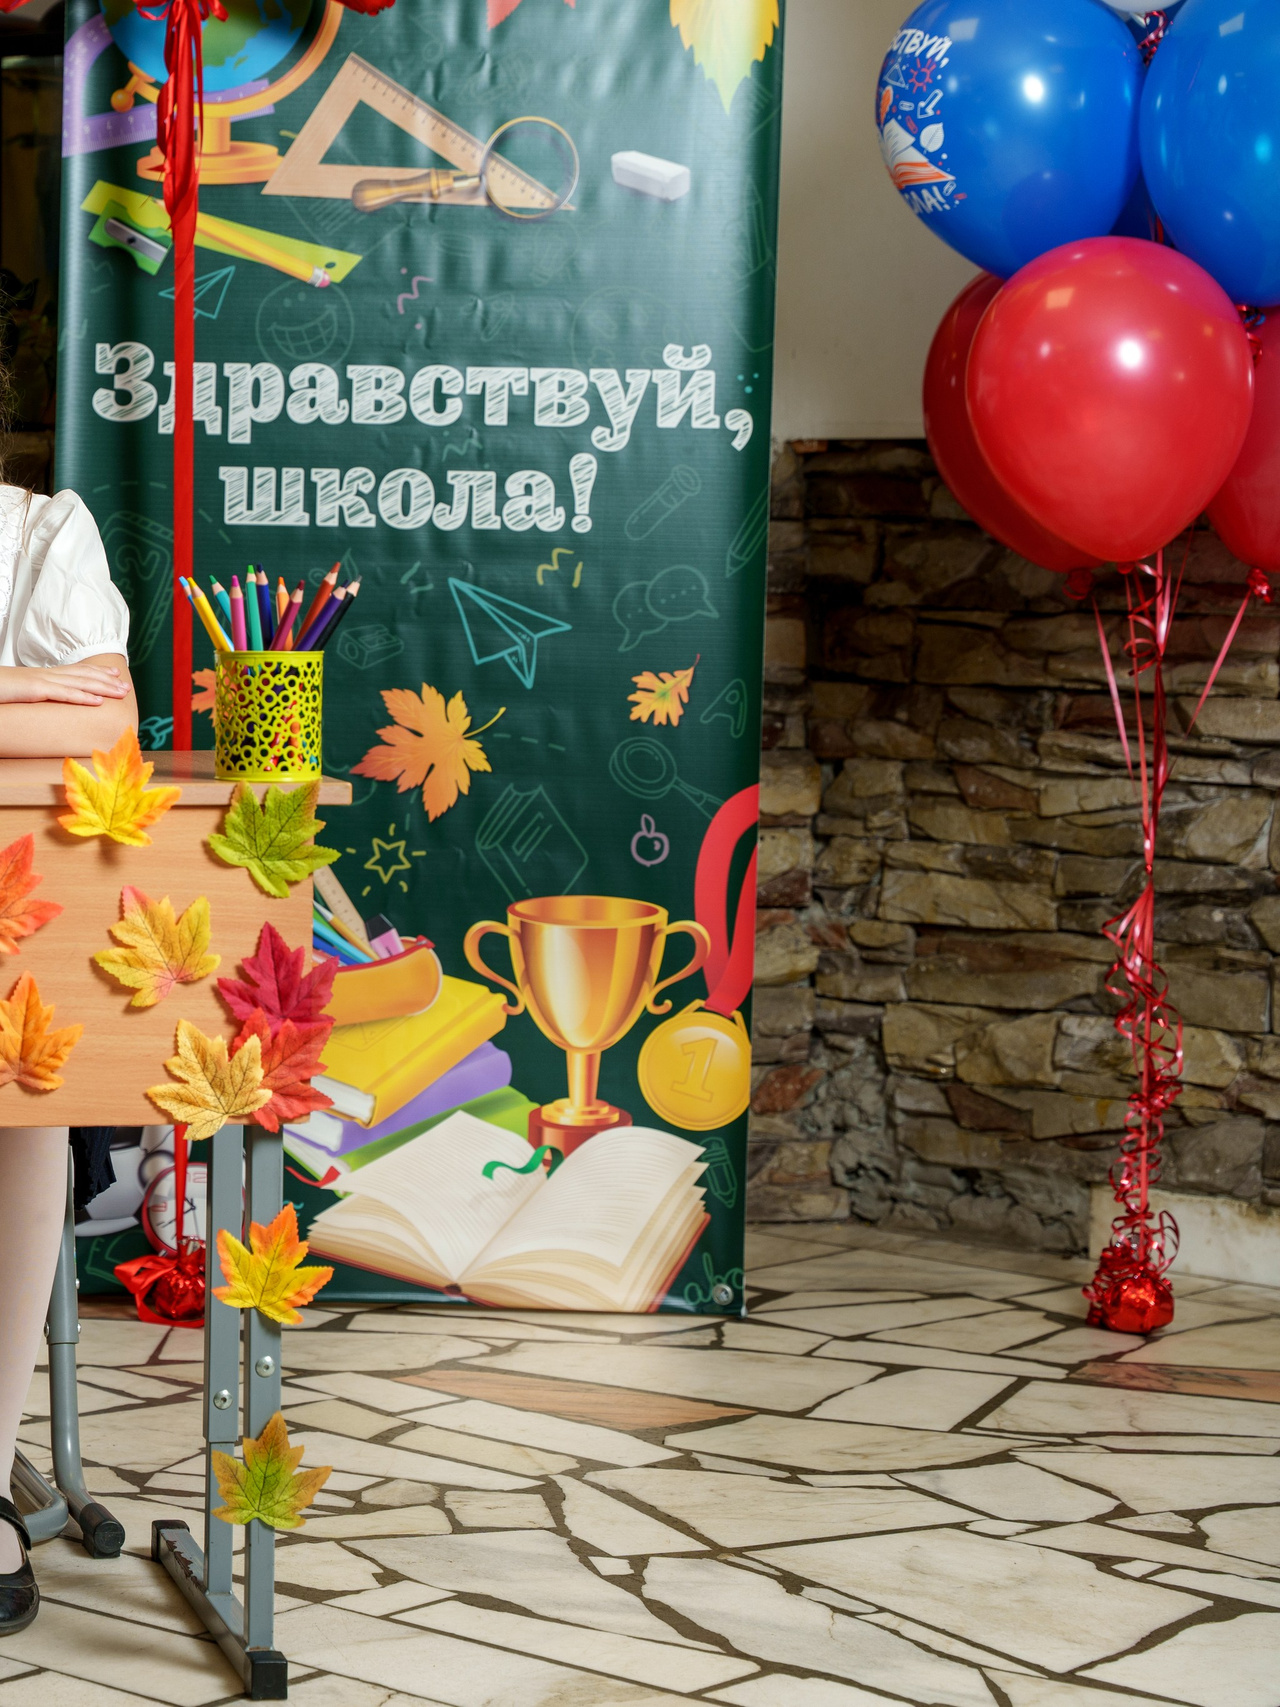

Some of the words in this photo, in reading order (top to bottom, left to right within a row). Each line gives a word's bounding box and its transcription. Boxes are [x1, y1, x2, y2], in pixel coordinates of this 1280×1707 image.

[91, 340, 754, 452] Здравствуй,
[219, 452, 599, 533] школа!
[669, 1036, 718, 1103] 1
